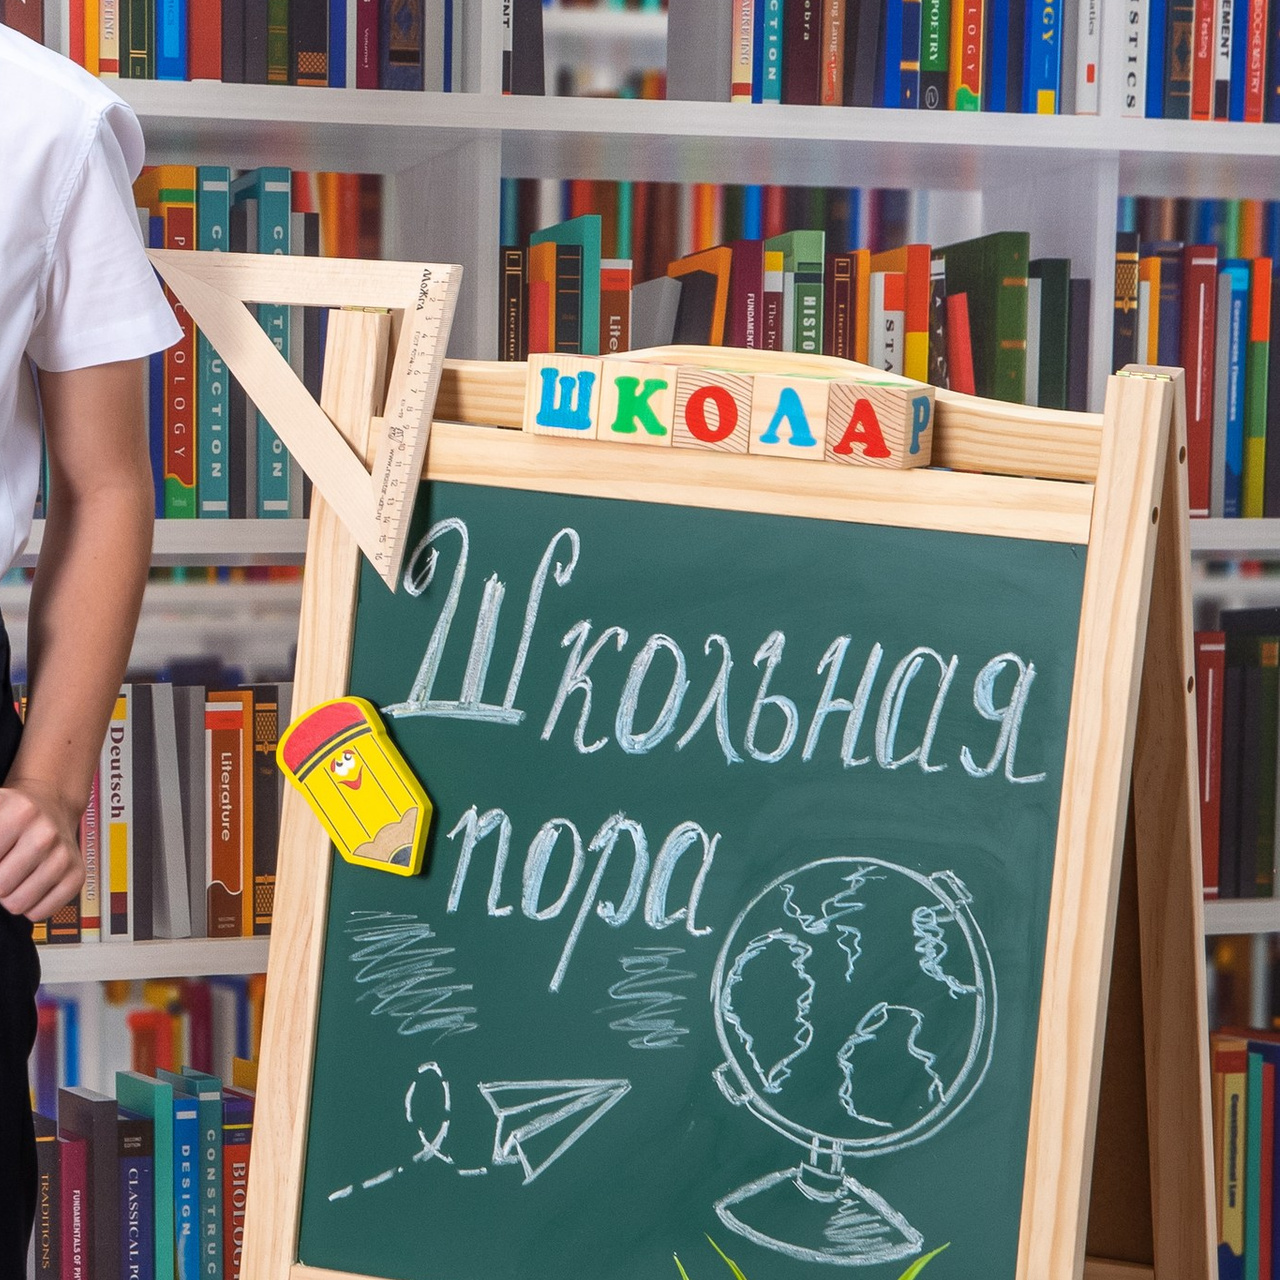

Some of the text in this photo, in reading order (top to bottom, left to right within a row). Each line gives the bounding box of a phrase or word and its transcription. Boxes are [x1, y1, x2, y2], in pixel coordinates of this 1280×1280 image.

[416, 268, 432, 311] Можга
[802, 296, 817, 351] HISTO
[535, 366, 892, 460] ШКОЛА
[380, 517, 1047, 784] Школьная
[109, 726, 125, 820] Deutsch
[221, 751, 232, 842] Literature
[445, 804, 722, 991] пора
[41, 1173, 51, 1269] TRADITIONS
[72, 1189, 81, 1253] FUNDAMENTALS
[128, 1168, 139, 1262] CLASSICAL
[181, 1144, 191, 1236] DESIGN
[73, 1254, 81, 1266] OF
